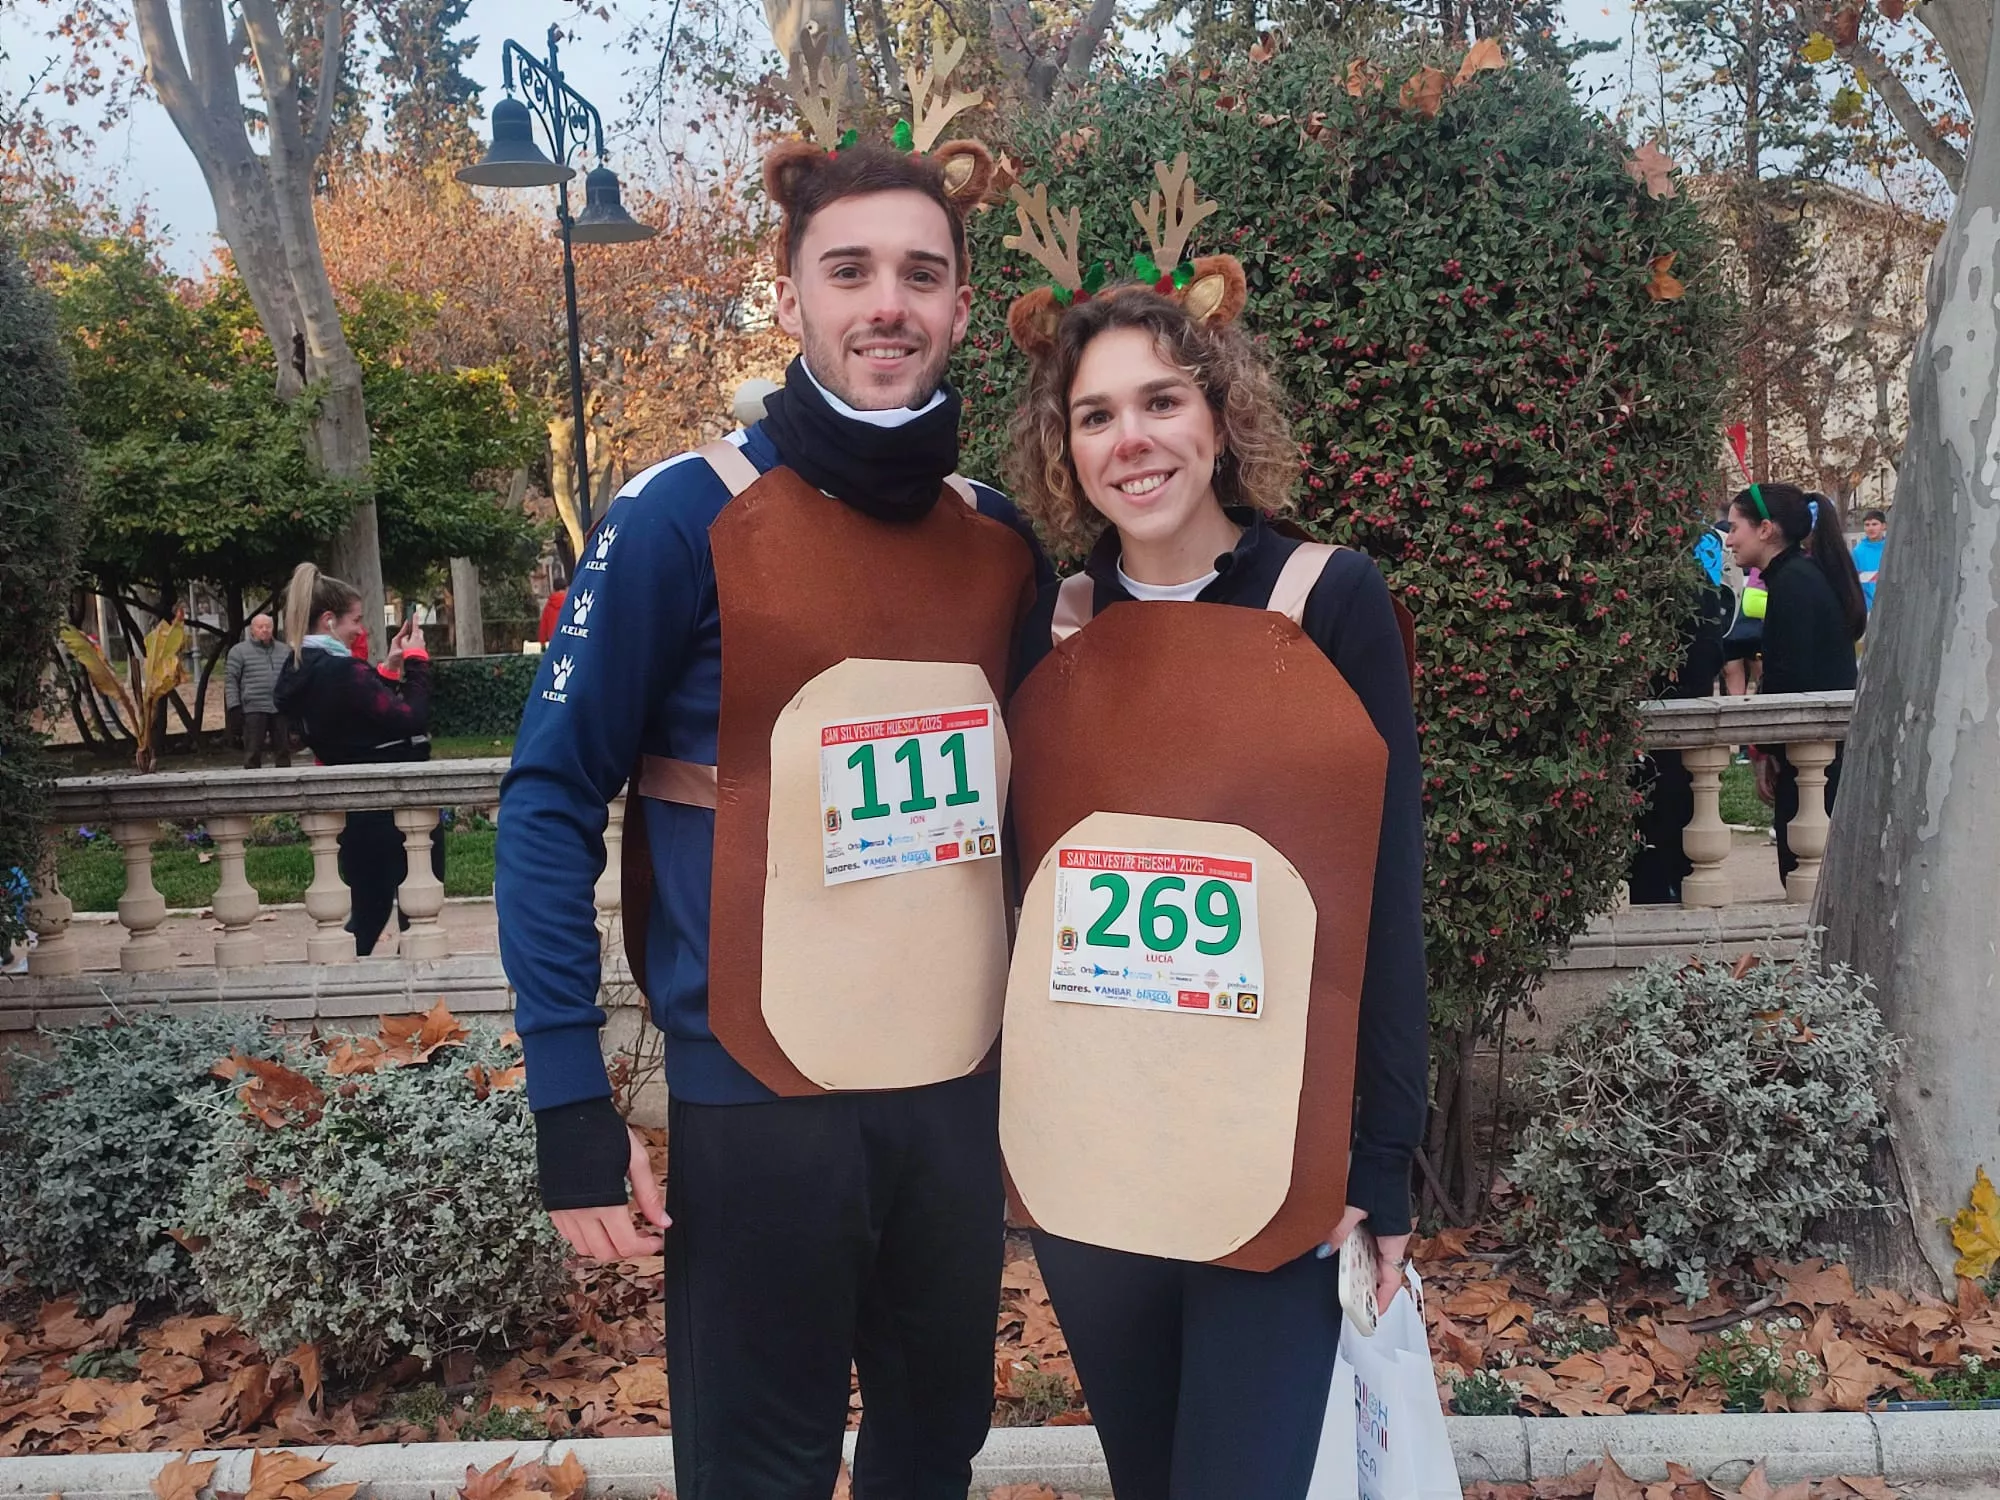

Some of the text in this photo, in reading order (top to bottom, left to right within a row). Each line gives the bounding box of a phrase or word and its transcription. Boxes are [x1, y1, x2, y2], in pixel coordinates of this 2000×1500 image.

[561, 625, 589, 638] KELME
[541, 690, 568, 703] KELME
[824, 727, 838, 744] SAN
[841, 722, 884, 741] SILVESTRE
[887, 718, 920, 735] HUESCA
[921, 715, 942, 731] 2025
[848, 732, 980, 820] 111
[1067, 851, 1086, 867] SAN
[1088, 853, 1135, 870] SILVESTRE
[1138, 855, 1177, 872] HUESCA
[1179, 857, 1204, 873] 2025
[1086, 873, 1241, 955] 269
[1146, 953, 1174, 964] LUCÍA
[1100, 986, 1131, 998] AMBAR
